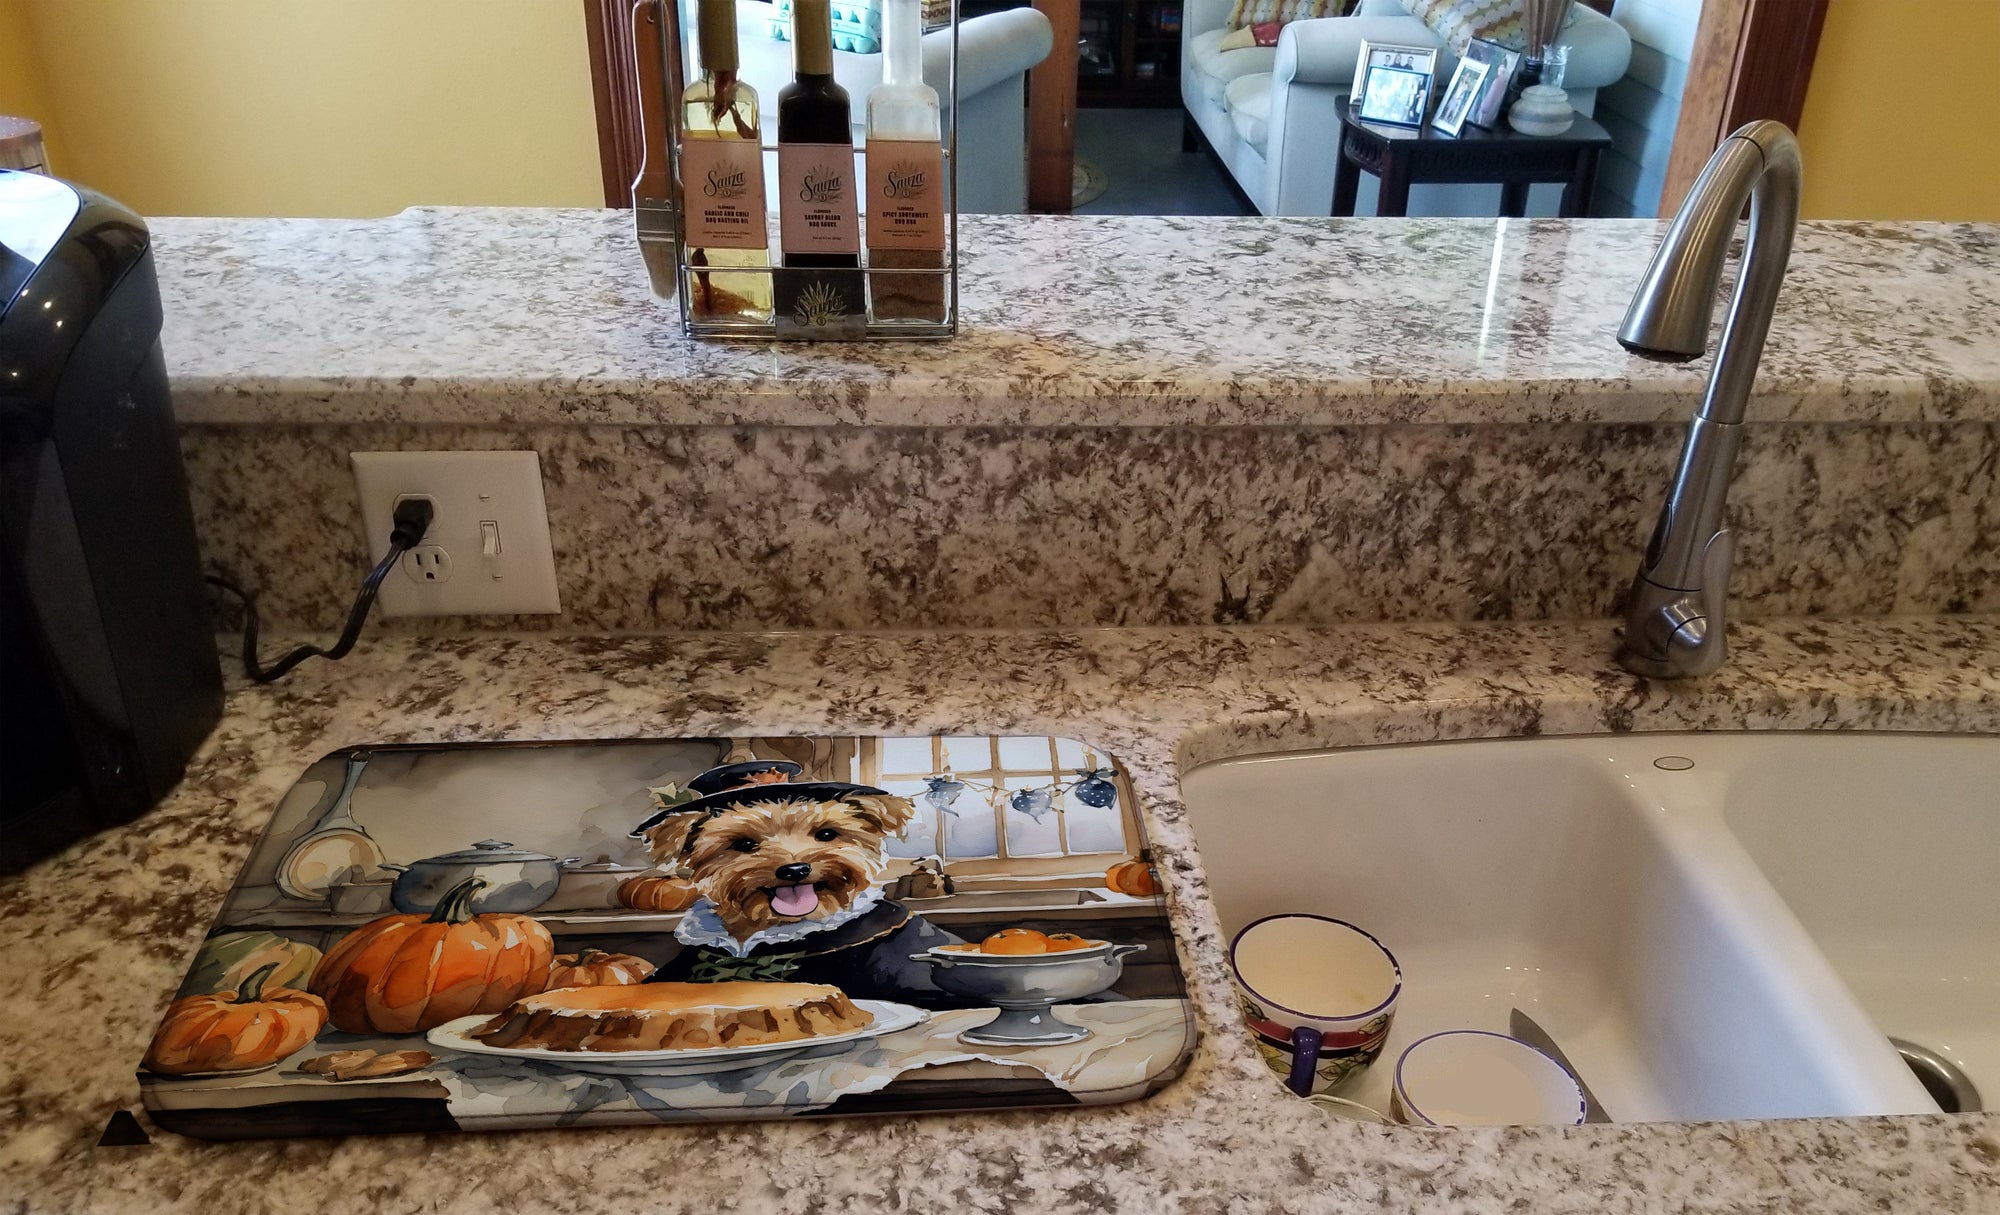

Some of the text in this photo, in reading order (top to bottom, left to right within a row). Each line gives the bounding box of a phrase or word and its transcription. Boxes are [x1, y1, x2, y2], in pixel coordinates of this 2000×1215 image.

[704, 170, 745, 197] Sauza
[800, 175, 841, 202] Sauza
[884, 171, 925, 198] Sauza
